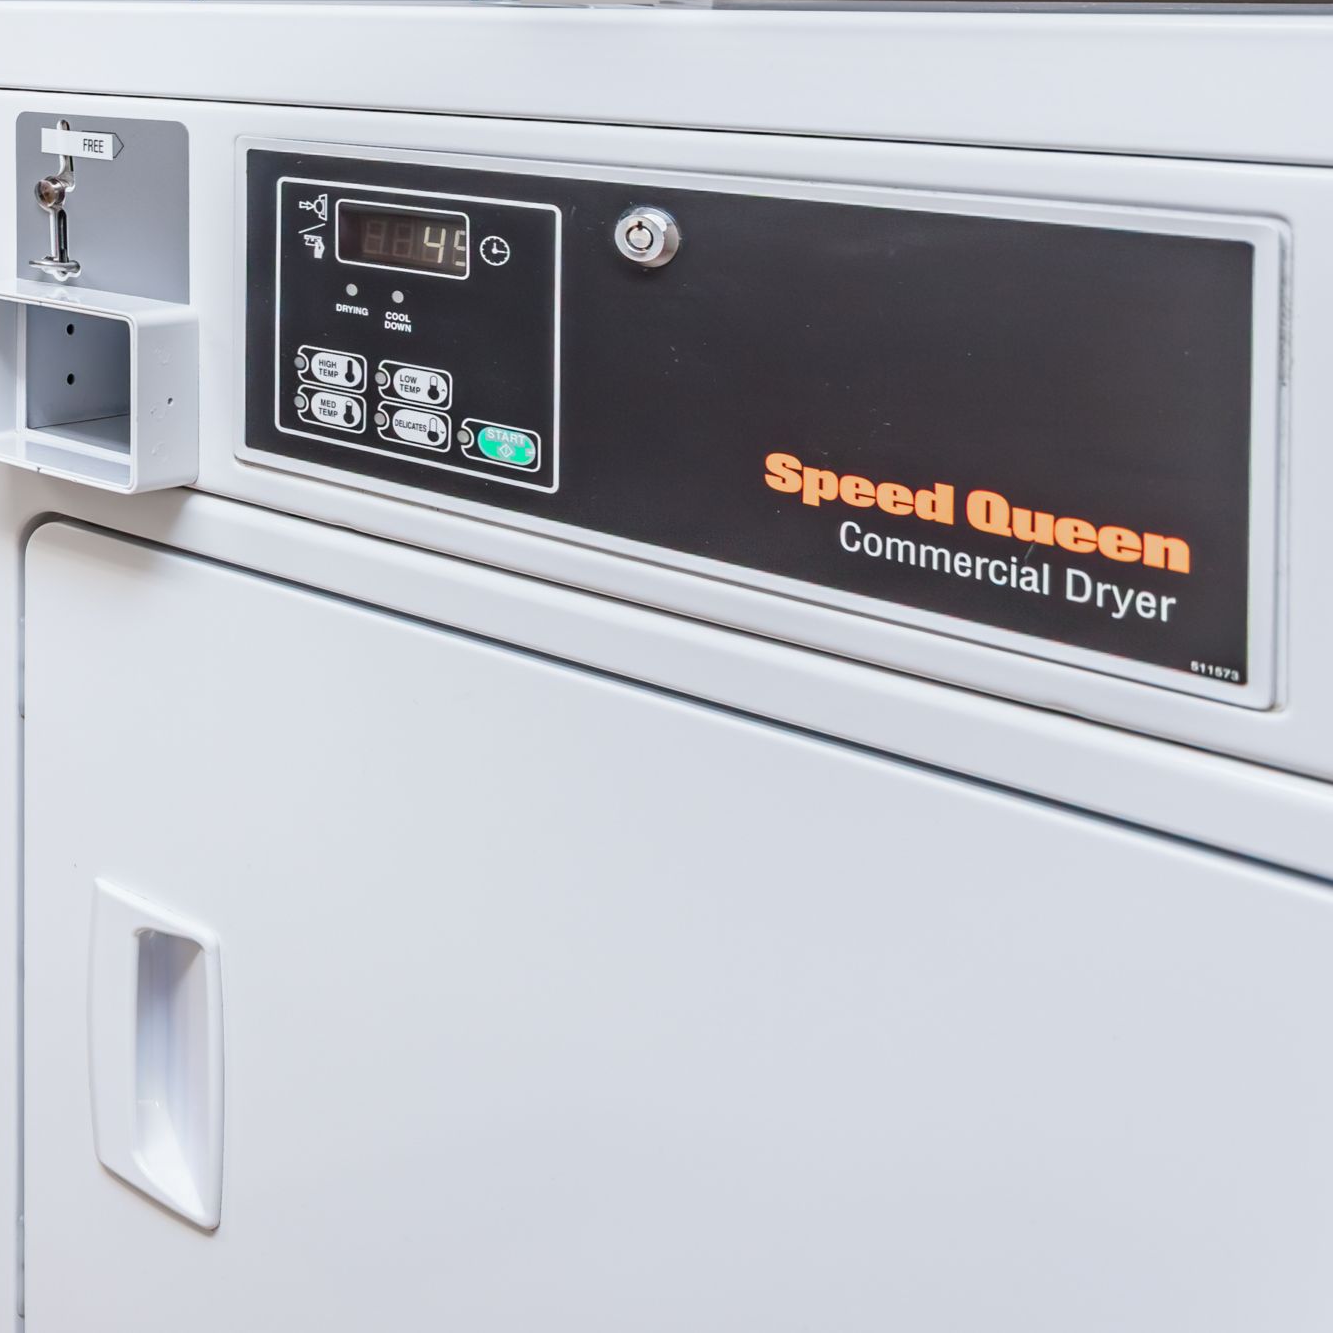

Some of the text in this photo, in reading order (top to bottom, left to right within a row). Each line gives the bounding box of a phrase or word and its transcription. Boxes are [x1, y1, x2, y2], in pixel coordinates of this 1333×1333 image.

[83, 138, 104, 153] FREE
[424, 226, 466, 266] 45
[335, 303, 369, 316] DRYING
[385, 311, 411, 323] COOL
[384, 320, 412, 333] DOWN
[318, 359, 337, 369] HIGH
[318, 368, 339, 378] TEMP
[399, 374, 417, 384] LOW
[399, 383, 421, 394] TEMP
[320, 399, 337, 409] MED
[318, 407, 339, 418] TEMP
[394, 419, 427, 432] DELICATES
[487, 428, 525, 445] START
[764, 452, 1190, 574] Speed Queen
[839, 520, 1177, 623] Commercial Dryer
